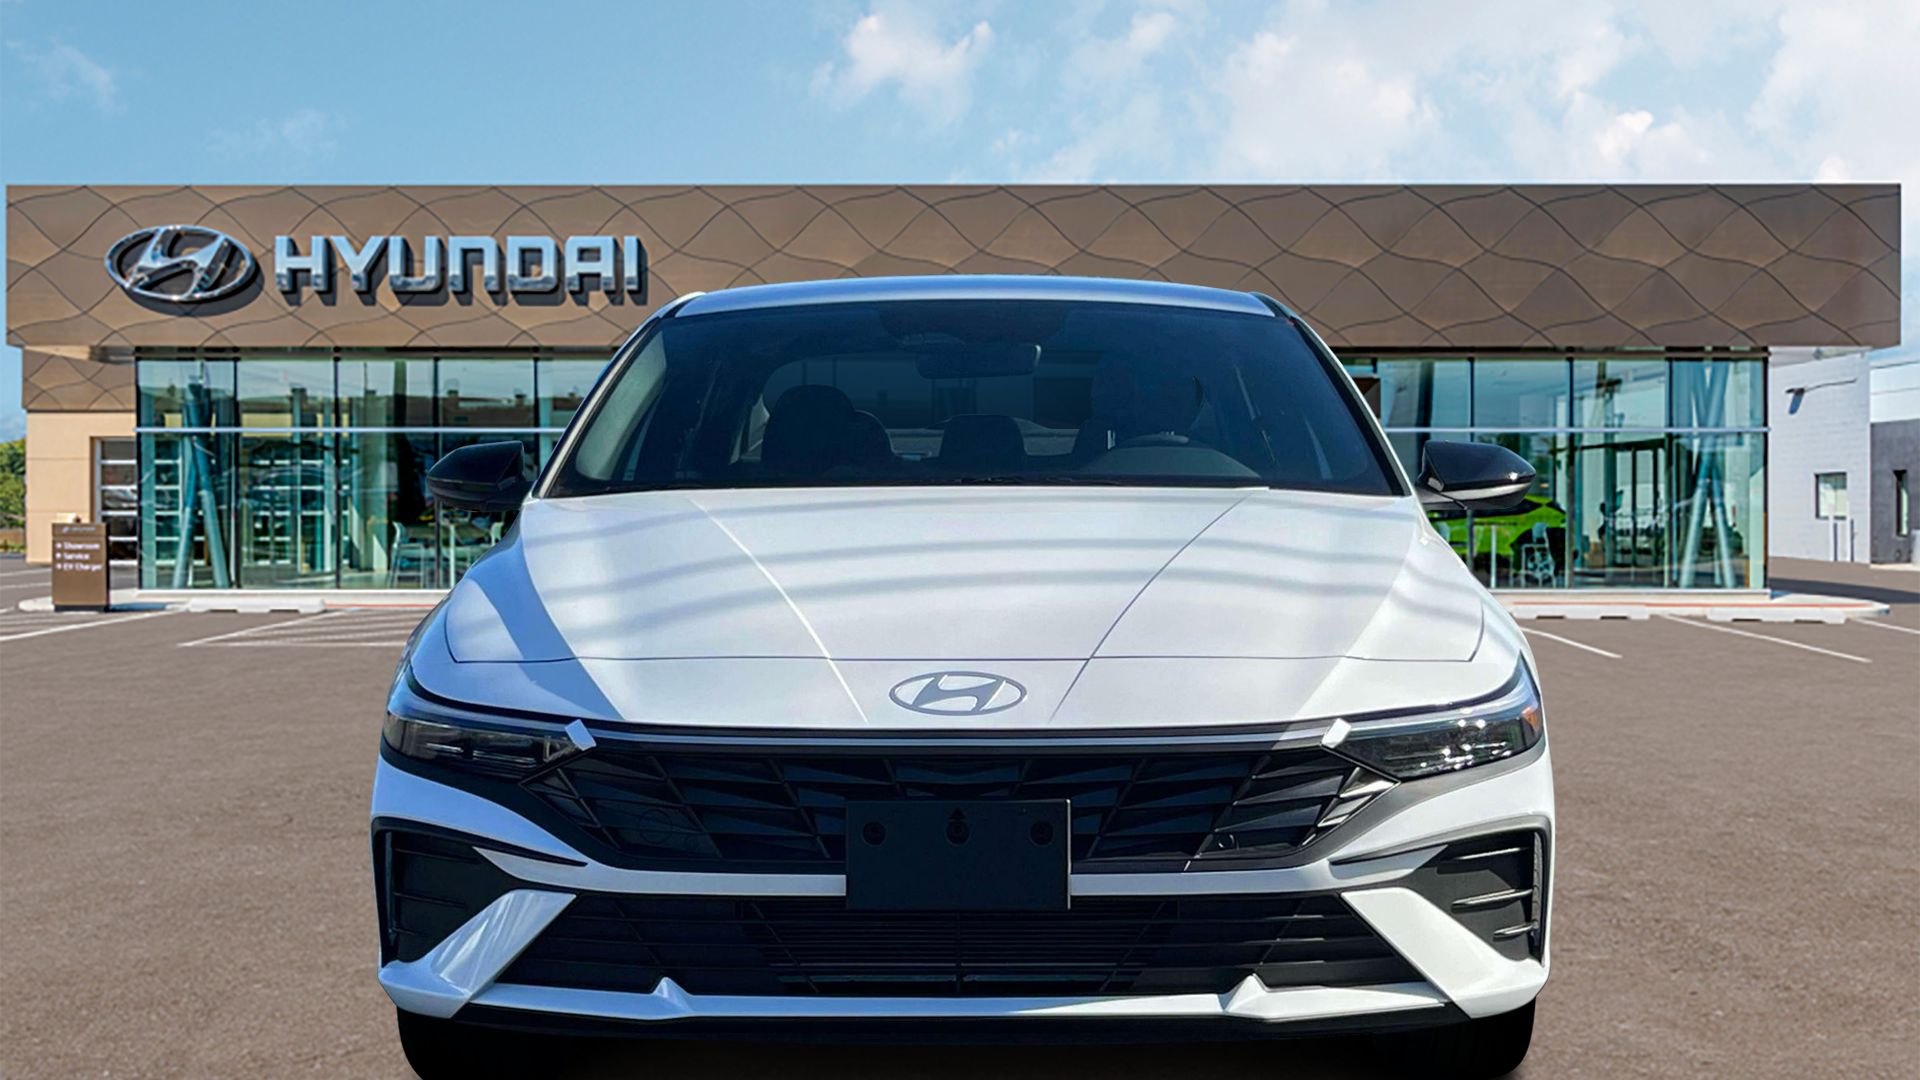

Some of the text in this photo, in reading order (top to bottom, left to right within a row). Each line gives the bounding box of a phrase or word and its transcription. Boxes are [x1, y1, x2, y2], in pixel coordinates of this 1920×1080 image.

[274, 235, 640, 294] HYUNDAI
[63, 552, 90, 560] Service
[75, 562, 102, 572] Charger
